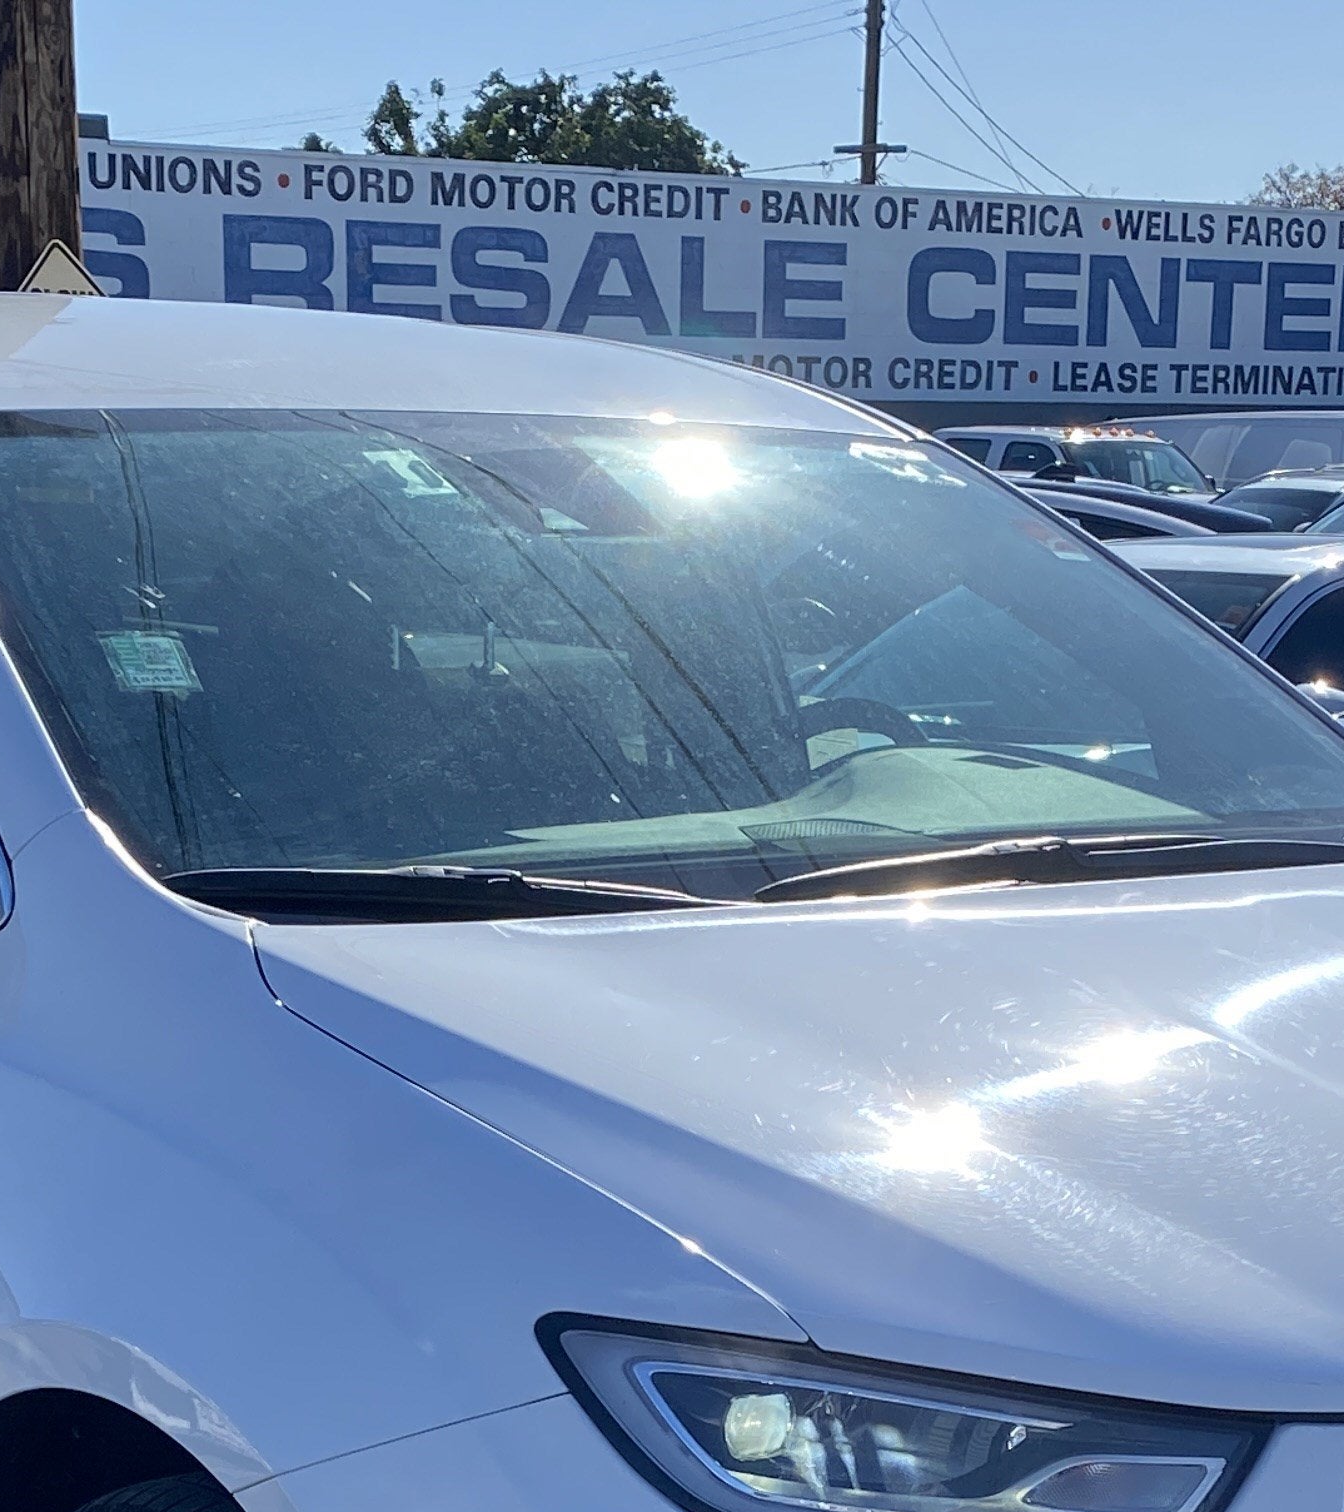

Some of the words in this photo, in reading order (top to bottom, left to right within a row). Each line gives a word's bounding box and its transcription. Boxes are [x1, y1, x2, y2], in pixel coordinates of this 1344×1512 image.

[87, 152, 262, 198] UNIONS
[303, 164, 414, 204] FORD
[430, 170, 577, 213] MOTOR
[590, 180, 731, 222] CREDIT
[760, 190, 861, 227] BANK
[874, 196, 919, 231] OF
[927, 199, 1084, 239] AMERICA
[1114, 209, 1216, 245] WELLS
[1226, 214, 1327, 249] FARGO
[223, 213, 847, 342] RESALE
[888, 357, 1018, 392] CREDIT
[1052, 361, 1158, 395] LEASE
